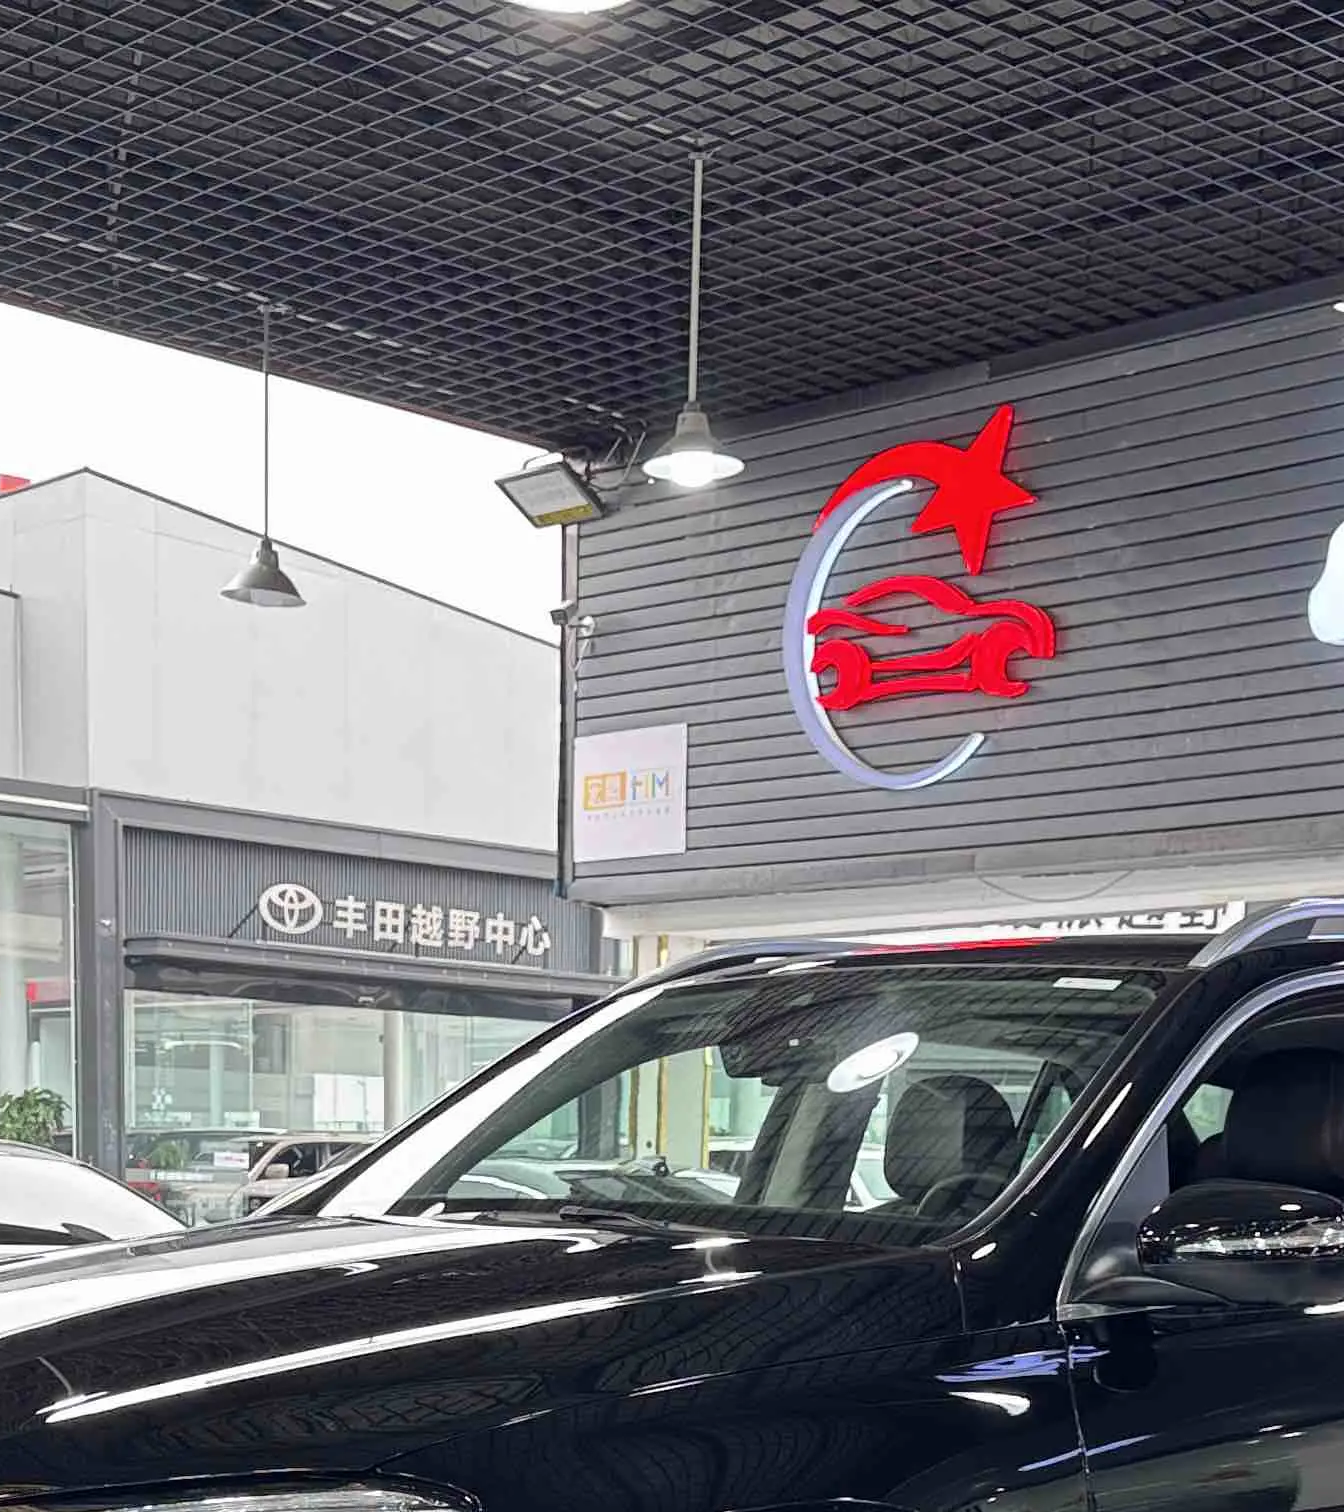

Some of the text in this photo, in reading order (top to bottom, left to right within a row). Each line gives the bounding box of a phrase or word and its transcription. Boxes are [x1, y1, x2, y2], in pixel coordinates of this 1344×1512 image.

[333, 895, 552, 956] 丰田越野中心
